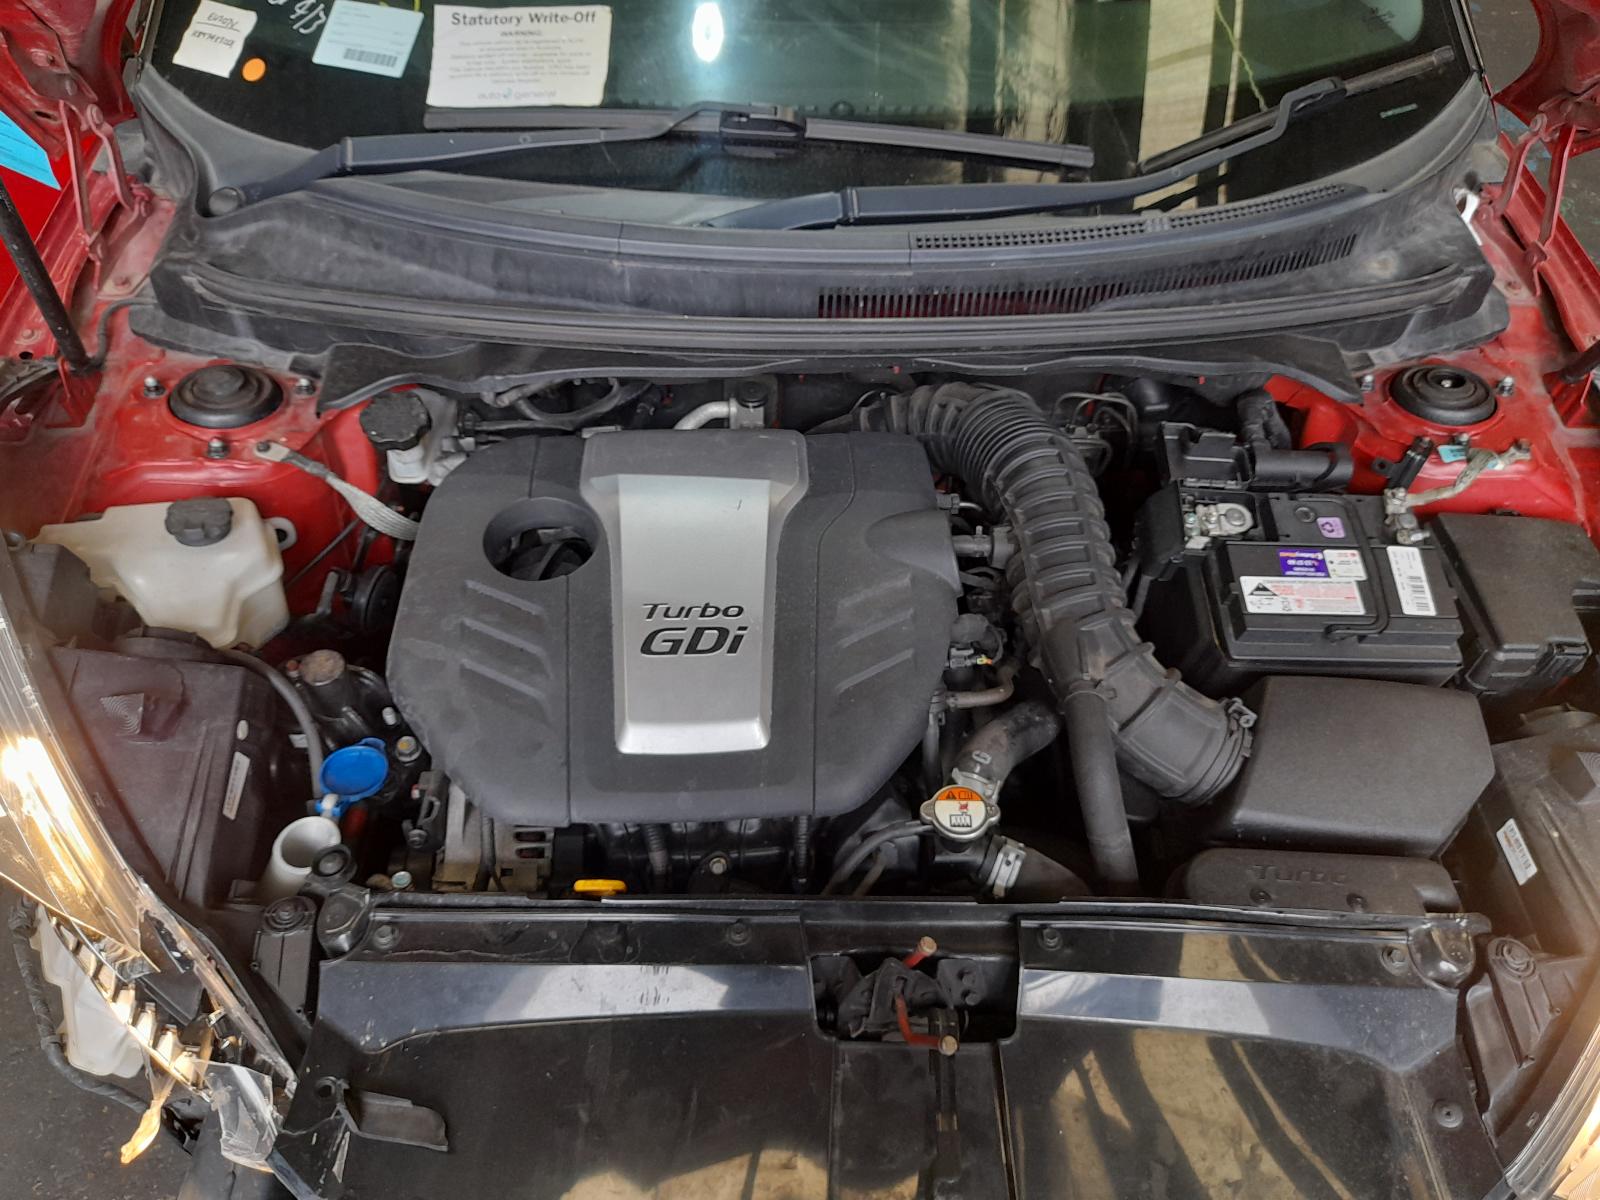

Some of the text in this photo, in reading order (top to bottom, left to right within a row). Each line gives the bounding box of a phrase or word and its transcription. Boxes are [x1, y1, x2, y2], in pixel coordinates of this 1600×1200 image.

[451, 11, 596, 27] Statutory Write-Off
[643, 602, 744, 620] Turbo
[640, 626, 749, 656] GDi
